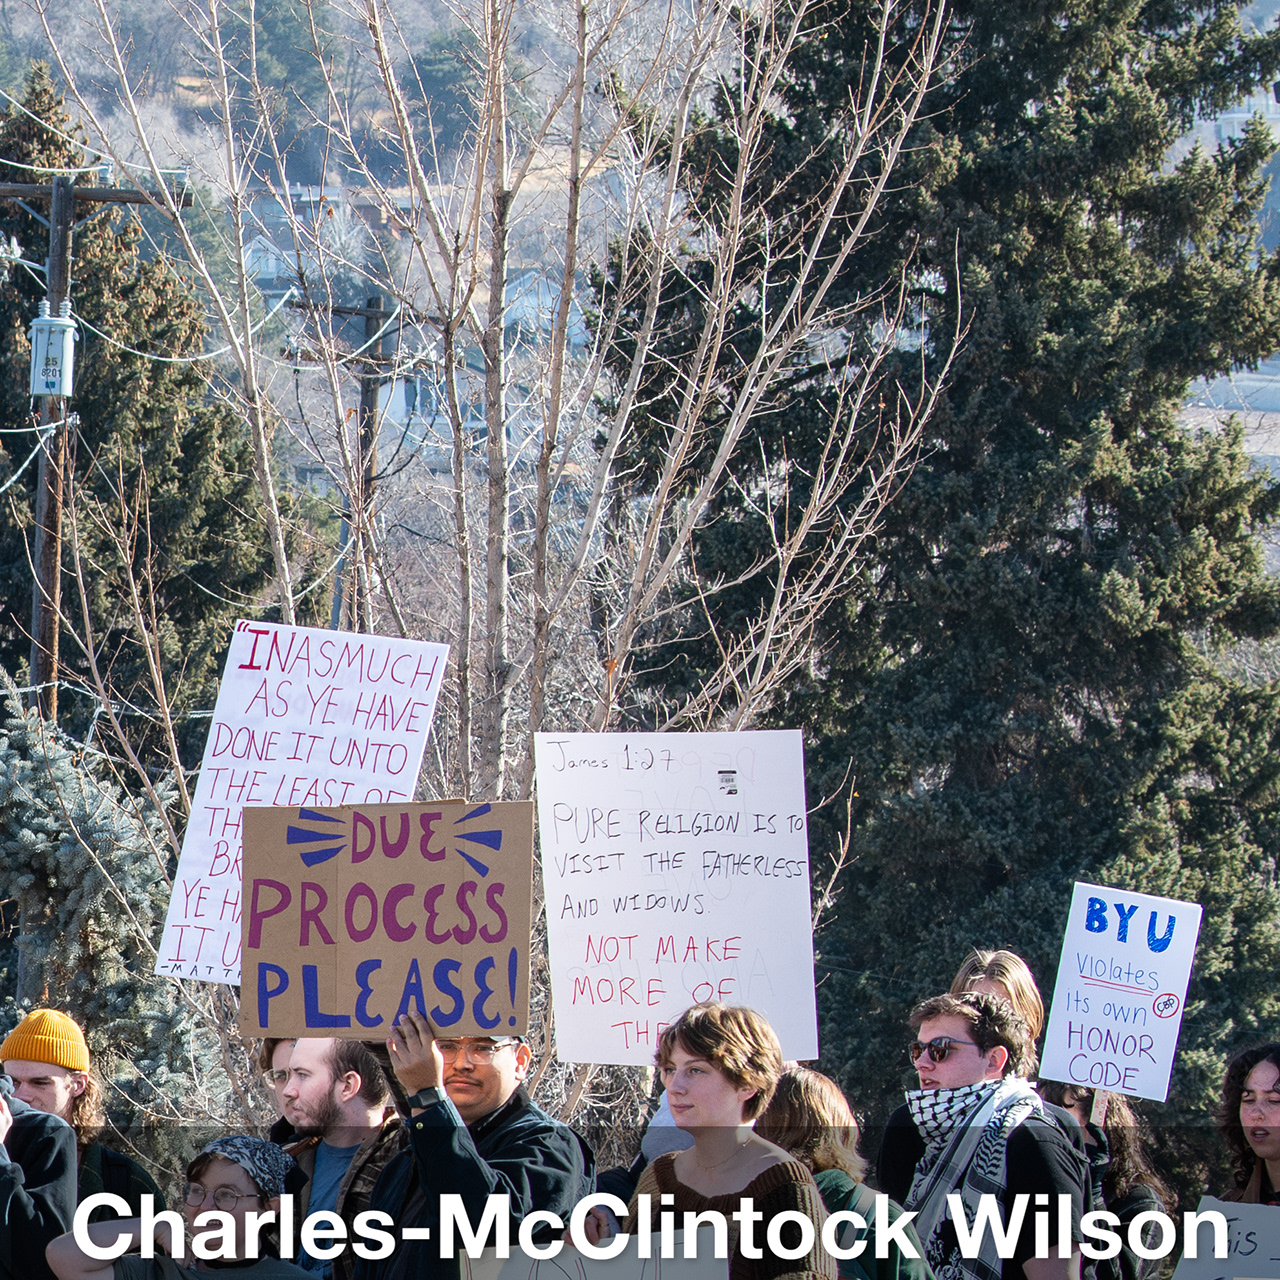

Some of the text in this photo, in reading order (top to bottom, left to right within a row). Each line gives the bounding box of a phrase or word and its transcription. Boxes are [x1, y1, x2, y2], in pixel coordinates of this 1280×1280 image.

[45, 357, 57, 366] 25
[244, 678, 429, 732] AS YE HAVE
[212, 722, 408, 775] DONE IT UNTO
[547, 740, 675, 772] James 1:27
[207, 767, 267, 802] THE
[273, 774, 355, 807] LEAST
[351, 811, 446, 863] DUE
[554, 802, 803, 843] PURE RELIGION IS TO
[554, 850, 806, 880] VISIT THE FATHERLESS
[183, 879, 210, 919] YE
[248, 878, 508, 949] PROCESS
[561, 893, 711, 919] AND WIDOWS.
[168, 924, 215, 962] IT
[1085, 896, 1177, 953] BYU
[585, 934, 742, 964] NOT MAKE
[257, 946, 518, 1029] PLEASE!
[573, 977, 736, 1006] MORE OF
[1066, 987, 1090, 1014] its
[1103, 1002, 1147, 1026] own
[1068, 1021, 1157, 1064] HONOR
[1069, 1053, 1140, 1091] CODE
